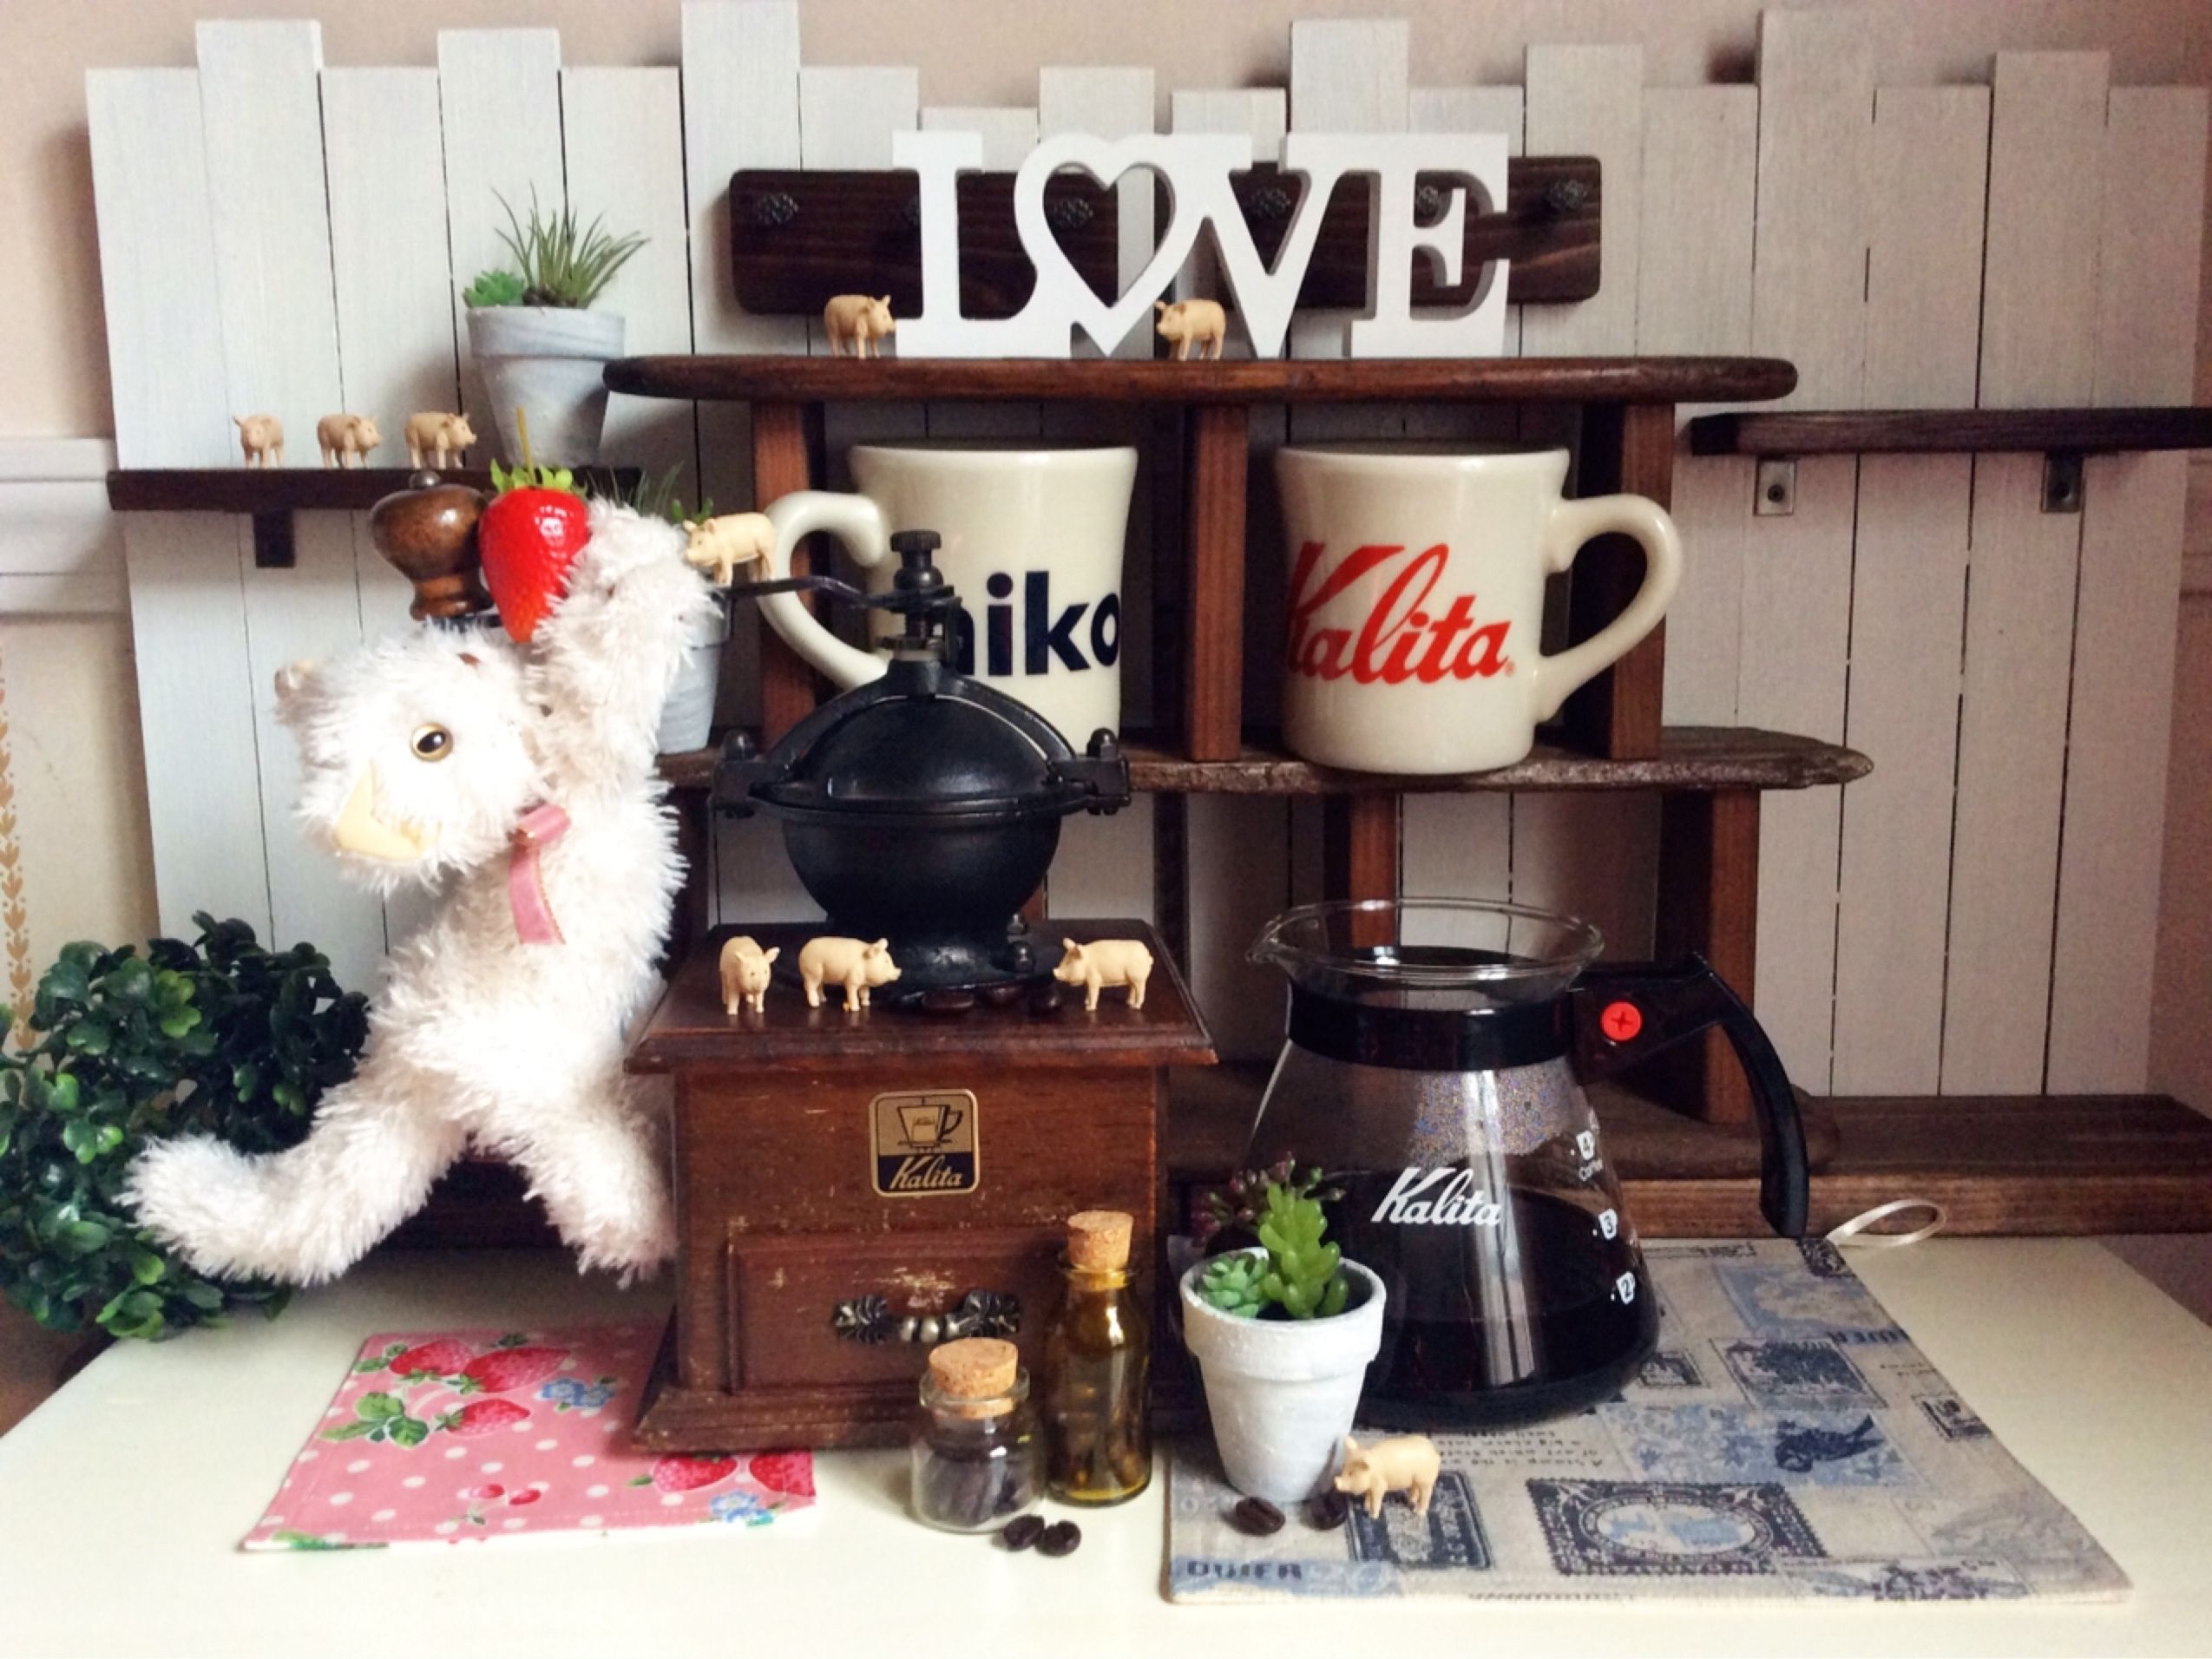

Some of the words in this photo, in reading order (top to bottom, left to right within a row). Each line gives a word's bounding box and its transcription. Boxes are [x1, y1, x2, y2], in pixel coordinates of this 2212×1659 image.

[1286, 541, 1513, 685] Kalita
[889, 1154, 963, 1190] Kalita
[1371, 1166, 1502, 1226] Kalita
